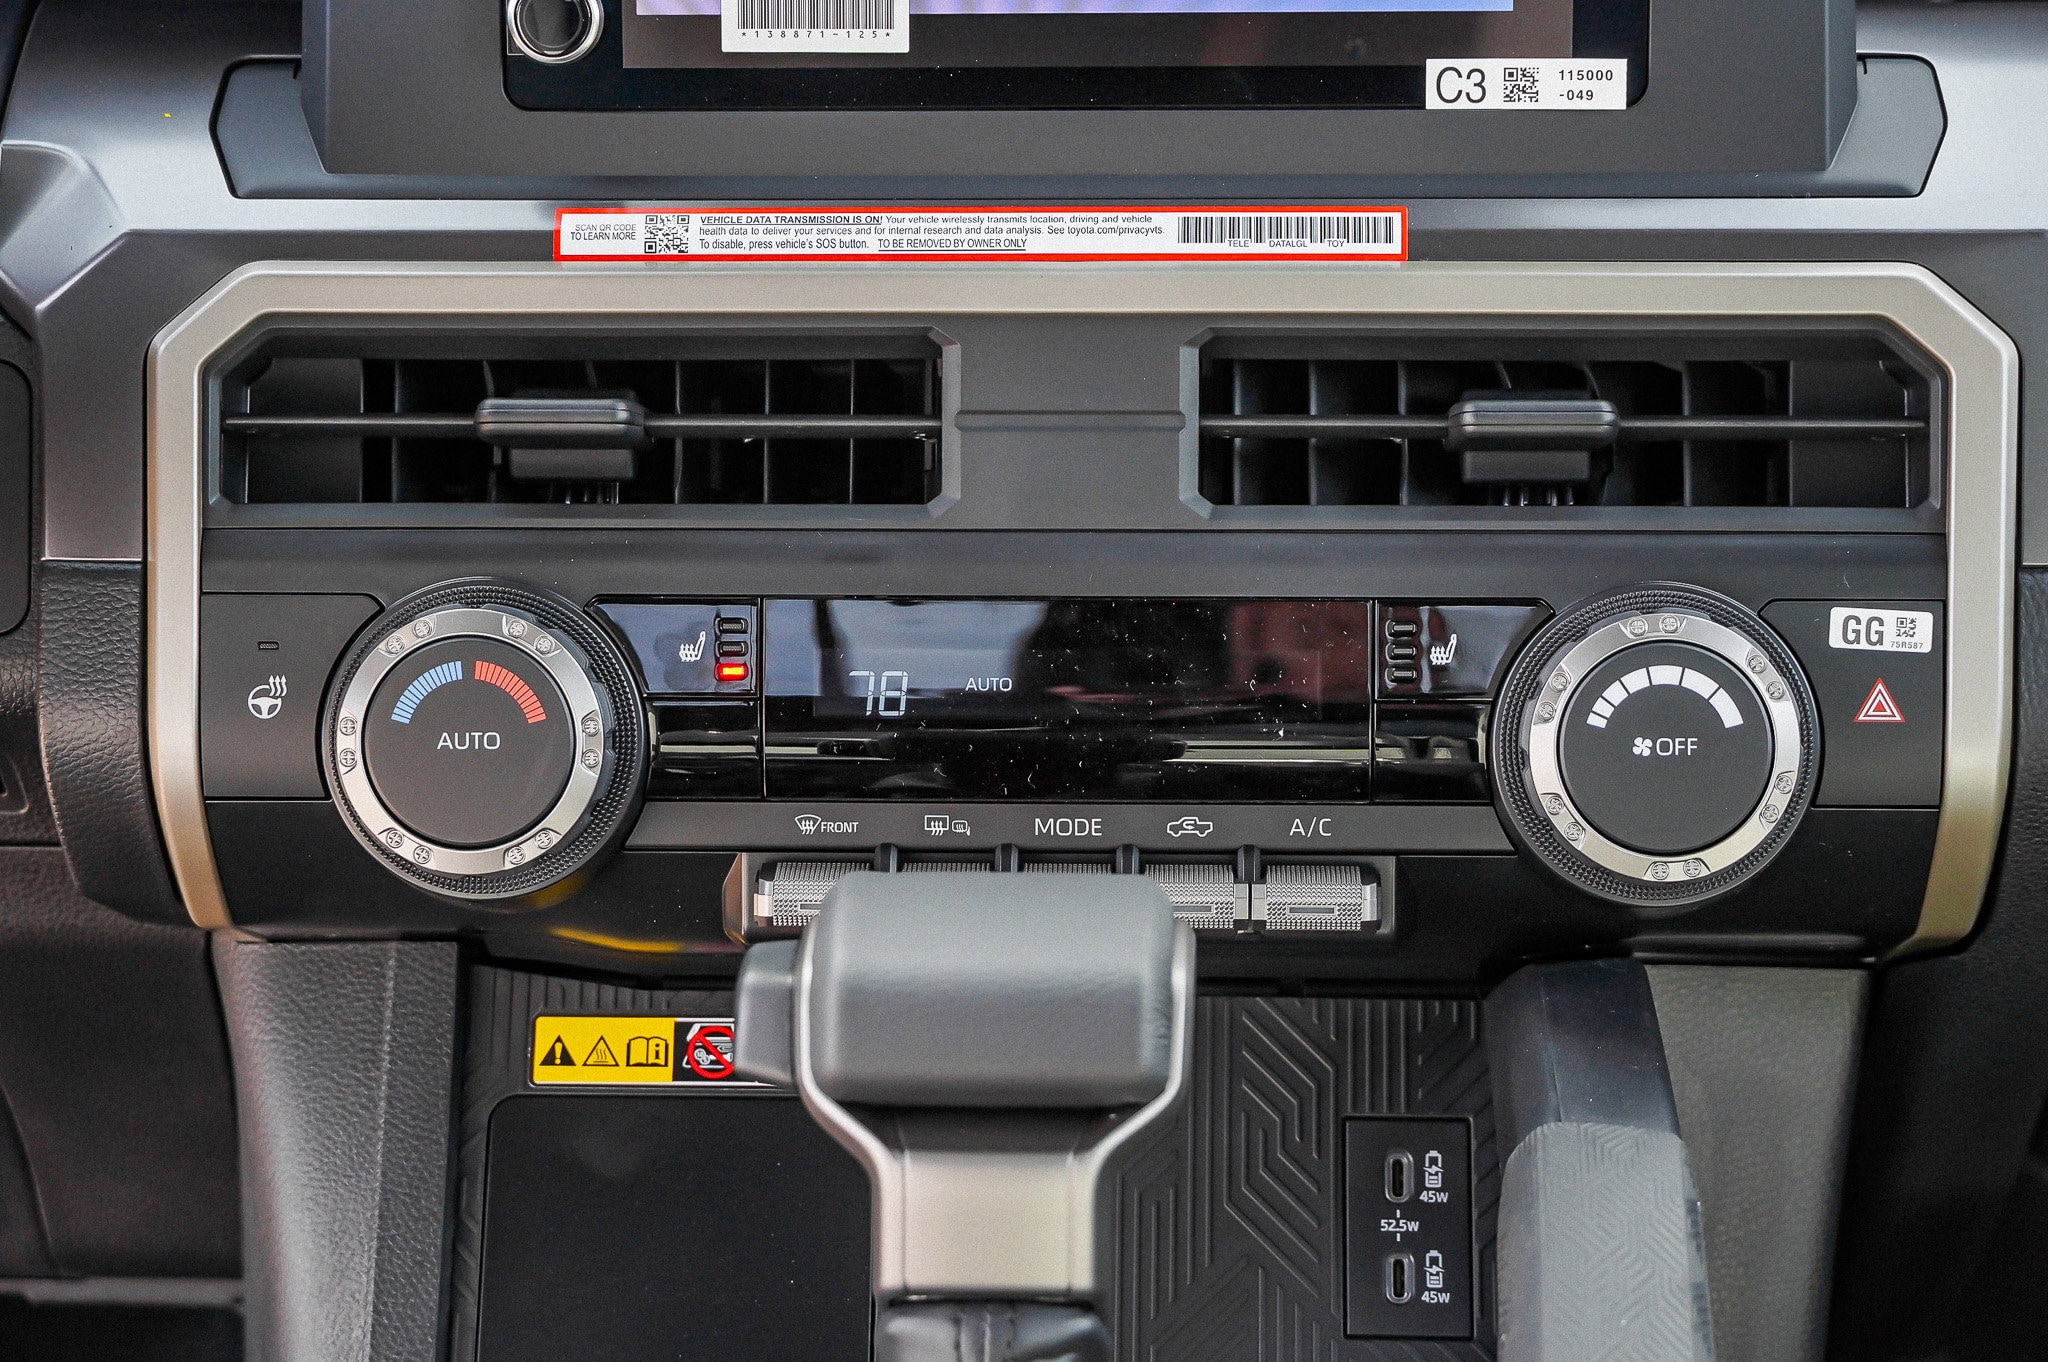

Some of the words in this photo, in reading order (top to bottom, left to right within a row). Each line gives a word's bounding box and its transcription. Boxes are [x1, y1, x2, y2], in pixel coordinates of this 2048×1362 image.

[1558, 69, 1614, 82] 115000
[1436, 66, 1487, 104] C3
[1559, 89, 1594, 101] -049
[700, 215, 743, 223] VEHICLE
[745, 215, 772, 223] DATA
[774, 215, 850, 223] TRANSMISSION
[852, 215, 863, 223] IS
[865, 215, 883, 224] ON!
[886, 215, 906, 224] Your
[908, 215, 939, 223] vehicle
[941, 215, 985, 225] wirelessly
[987, 215, 1027, 223] transmits
[1029, 215, 1067, 225] location,
[1069, 215, 1099, 225] driving
[1101, 215, 1119, 223] and
[1121, 215, 1153, 223] vehicle
[575, 224, 598, 232] SCAN
[600, 224, 612, 232] QR
[614, 224, 637, 232] CODE
[699, 227, 726, 236] health
[728, 227, 748, 236] data
[750, 227, 760, 236] to
[762, 227, 791, 236] deliver
[794, 228, 813, 238] your
[815, 227, 853, 235] services
[854, 226, 872, 235] and
[874, 226, 886, 235] for
[888, 226, 921, 235] internal
[923, 226, 963, 235] research
[964, 226, 982, 235] and
[984, 226, 1004, 235] data
[1005, 225, 1044, 236] analysis.
[1047, 225, 1065, 235] See
[570, 232, 582, 241] TO
[583, 232, 610, 241] LEARN
[611, 232, 636, 241] MORE
[699, 238, 710, 249] To
[712, 238, 746, 250] disable,
[748, 240, 773, 251] press
[775, 238, 814, 249] vehicle's
[815, 238, 837, 249] SOS
[839, 238, 870, 249] button.
[878, 238, 891, 248] TO
[892, 238, 904, 248] BE
[906, 238, 952, 248] REMOVED
[953, 238, 966, 248] BY
[967, 238, 1002, 248] OWNER
[1003, 238, 1028, 248] ONLY
[1228, 239, 1250, 248] TELE
[1269, 239, 1308, 248] DATALGL
[1327, 239, 1345, 248] TOY
[1841, 614, 1885, 646] GG
[964, 677, 1013, 692] AUTO
[849, 671, 909, 717] 78
[437, 732, 501, 751] AUTO
[1655, 738, 1698, 756] OFF
[820, 821, 859, 834] FRONT
[1034, 818, 1103, 837] MODE
[1289, 817, 1332, 837] A/C
[1419, 1190, 1449, 1203] 45W
[1380, 1219, 1420, 1232] 52.5W
[1421, 1291, 1450, 1304] 45W
